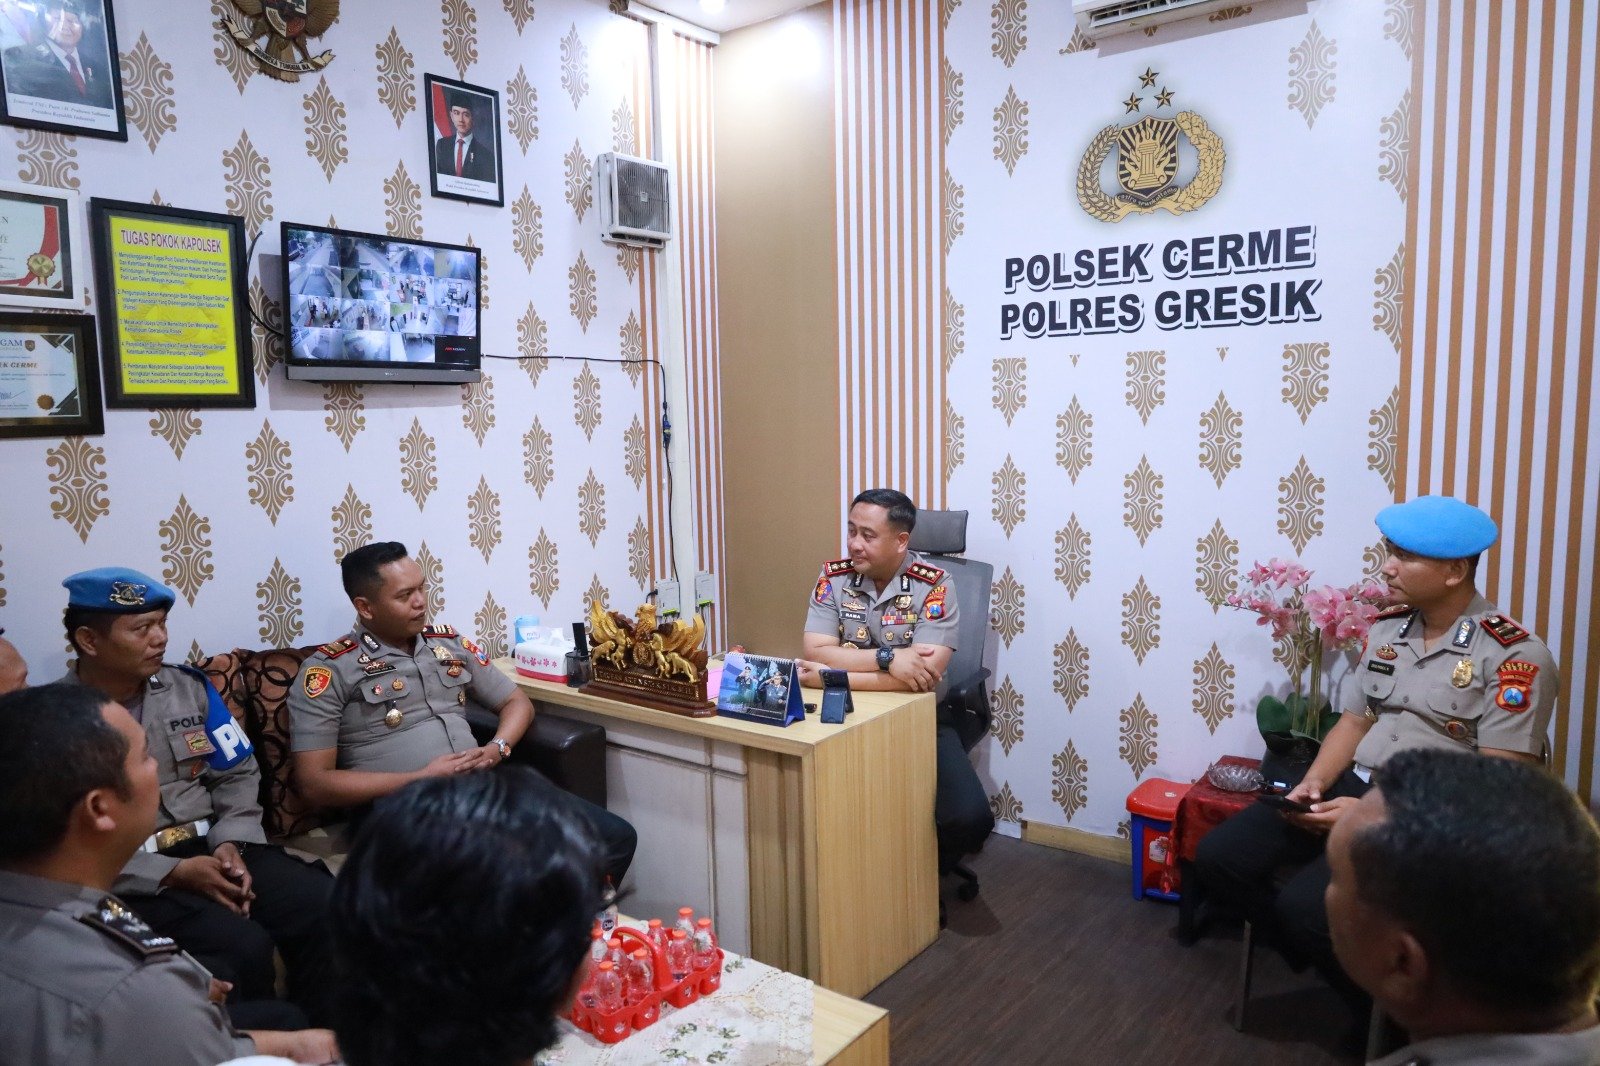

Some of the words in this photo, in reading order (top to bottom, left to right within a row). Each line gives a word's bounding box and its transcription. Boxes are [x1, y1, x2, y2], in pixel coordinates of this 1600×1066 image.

[121, 229, 149, 246] TUGAS
[151, 233, 180, 249] POKOK
[182, 236, 222, 252] KAPOLSEK
[1004, 242, 1154, 294] POLSEK
[1162, 225, 1317, 280] CERME
[1000, 293, 1146, 340] POLRES
[1154, 278, 1322, 331] GRESIK
